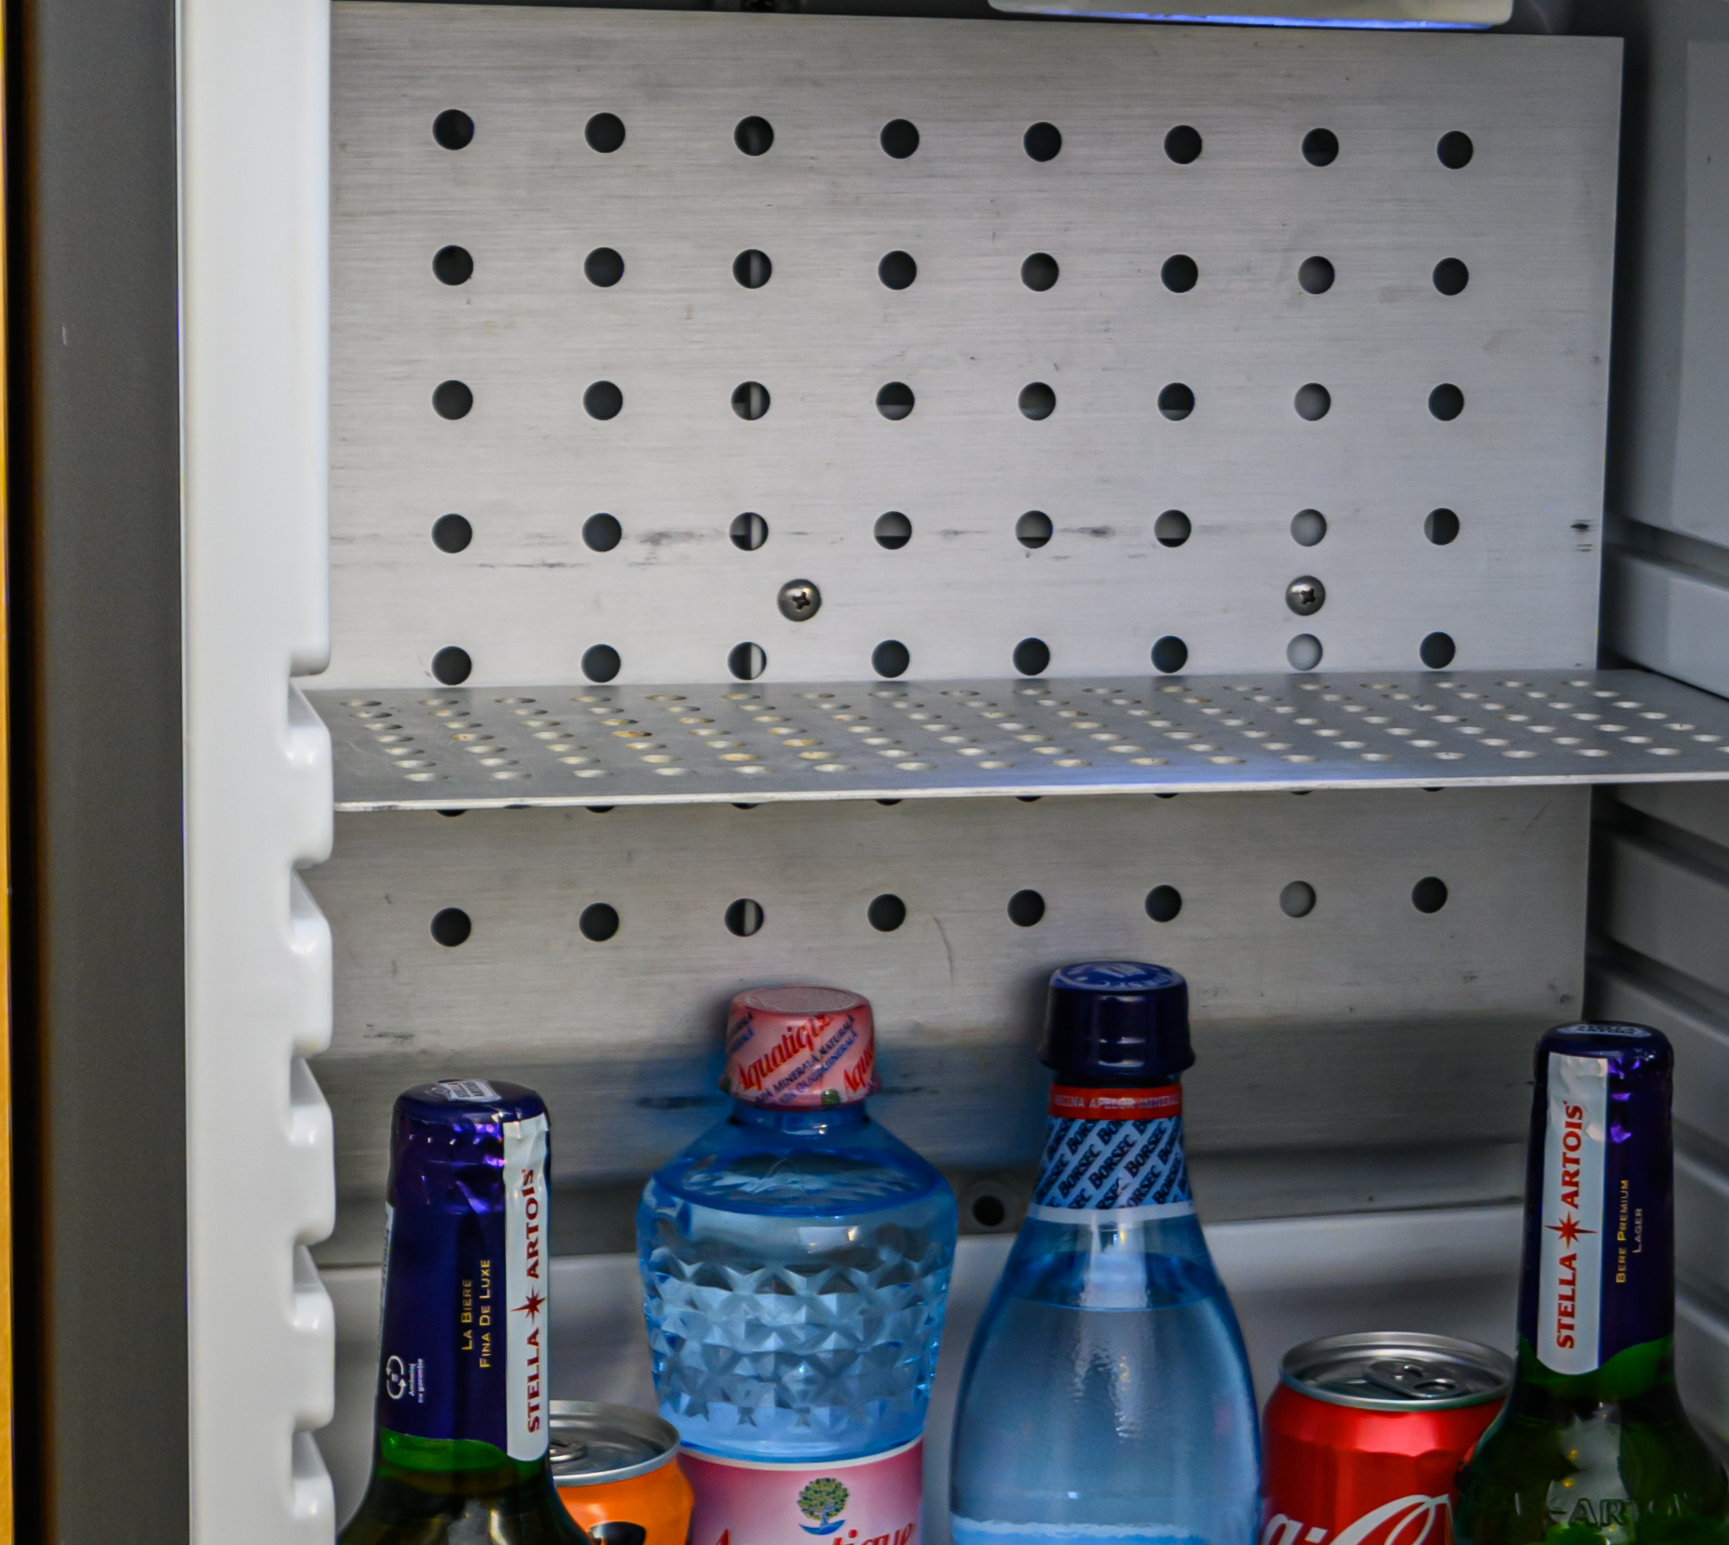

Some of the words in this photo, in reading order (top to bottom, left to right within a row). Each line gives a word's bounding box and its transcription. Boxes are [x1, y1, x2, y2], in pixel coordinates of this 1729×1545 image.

[1058, 1144, 1102, 1199] BORSEC
[1088, 1134, 1138, 1191] BORSEC
[1124, 1121, 1168, 1179] BORSEC
[1560, 1100, 1584, 1210] ARTOIS
[520, 1167, 541, 1279] ARTOIS
[1617, 1179, 1629, 1242] PREMIUM
[460, 1278, 473, 1323] BIERE
[479, 1259, 491, 1299] LUXE
[1556, 1252, 1578, 1350] STELLA
[461, 1329, 474, 1351] LA
[479, 1305, 491, 1326] DE
[479, 1333, 491, 1368] FINA
[526, 1328, 541, 1434] STELLA
